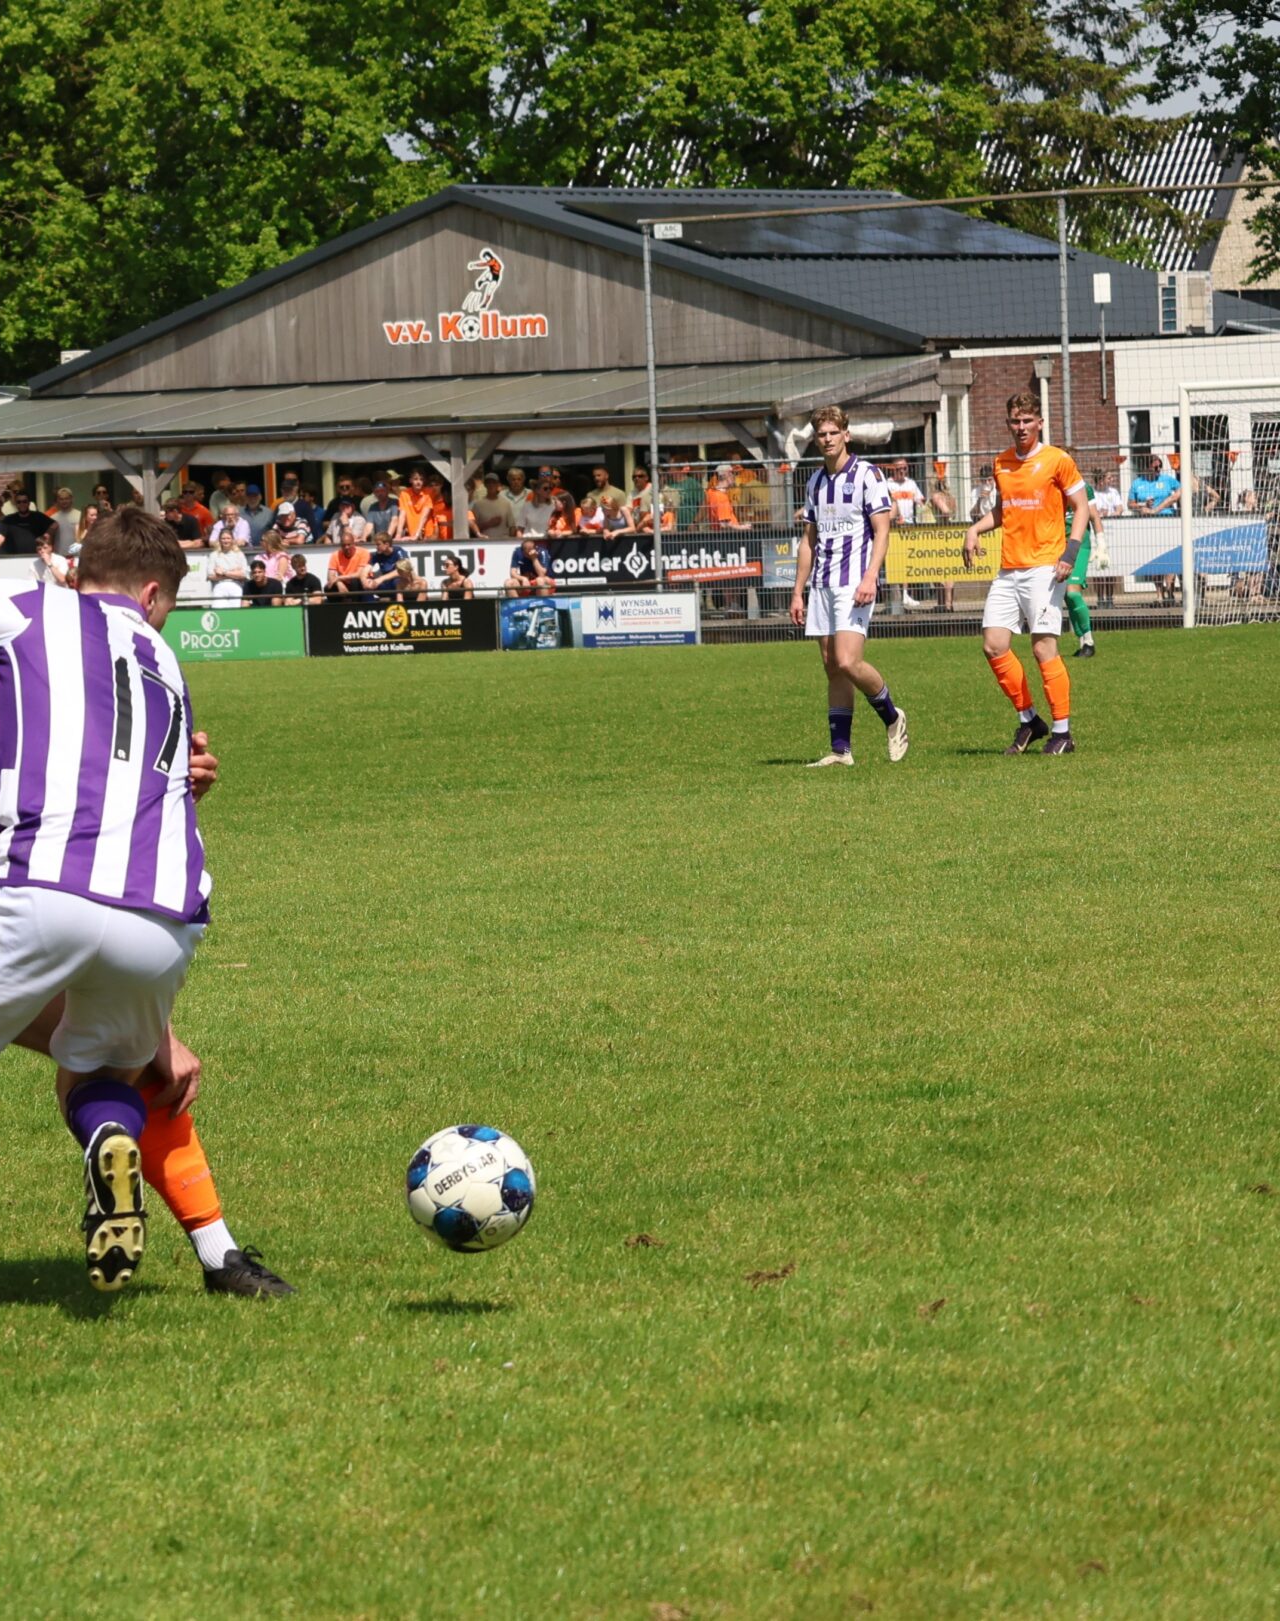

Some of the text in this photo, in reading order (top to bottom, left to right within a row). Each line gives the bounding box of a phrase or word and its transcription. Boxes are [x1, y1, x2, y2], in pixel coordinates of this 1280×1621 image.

[384, 321, 431, 344] v.v.
[898, 529, 995, 542] Warmtepoen
[551, 551, 621, 573] oorder
[620, 599, 658, 607] WYNSMA
[343, 608, 462, 629] ANY TYME
[620, 607, 681, 616] MECHANISATIE
[180, 629, 240, 649] PROOST
[410, 629, 436, 637] SNACK
[444, 628, 462, 636] DINE
[390, 643, 414, 651] Kollum
[433, 1152, 497, 1196] DERBYSAR
